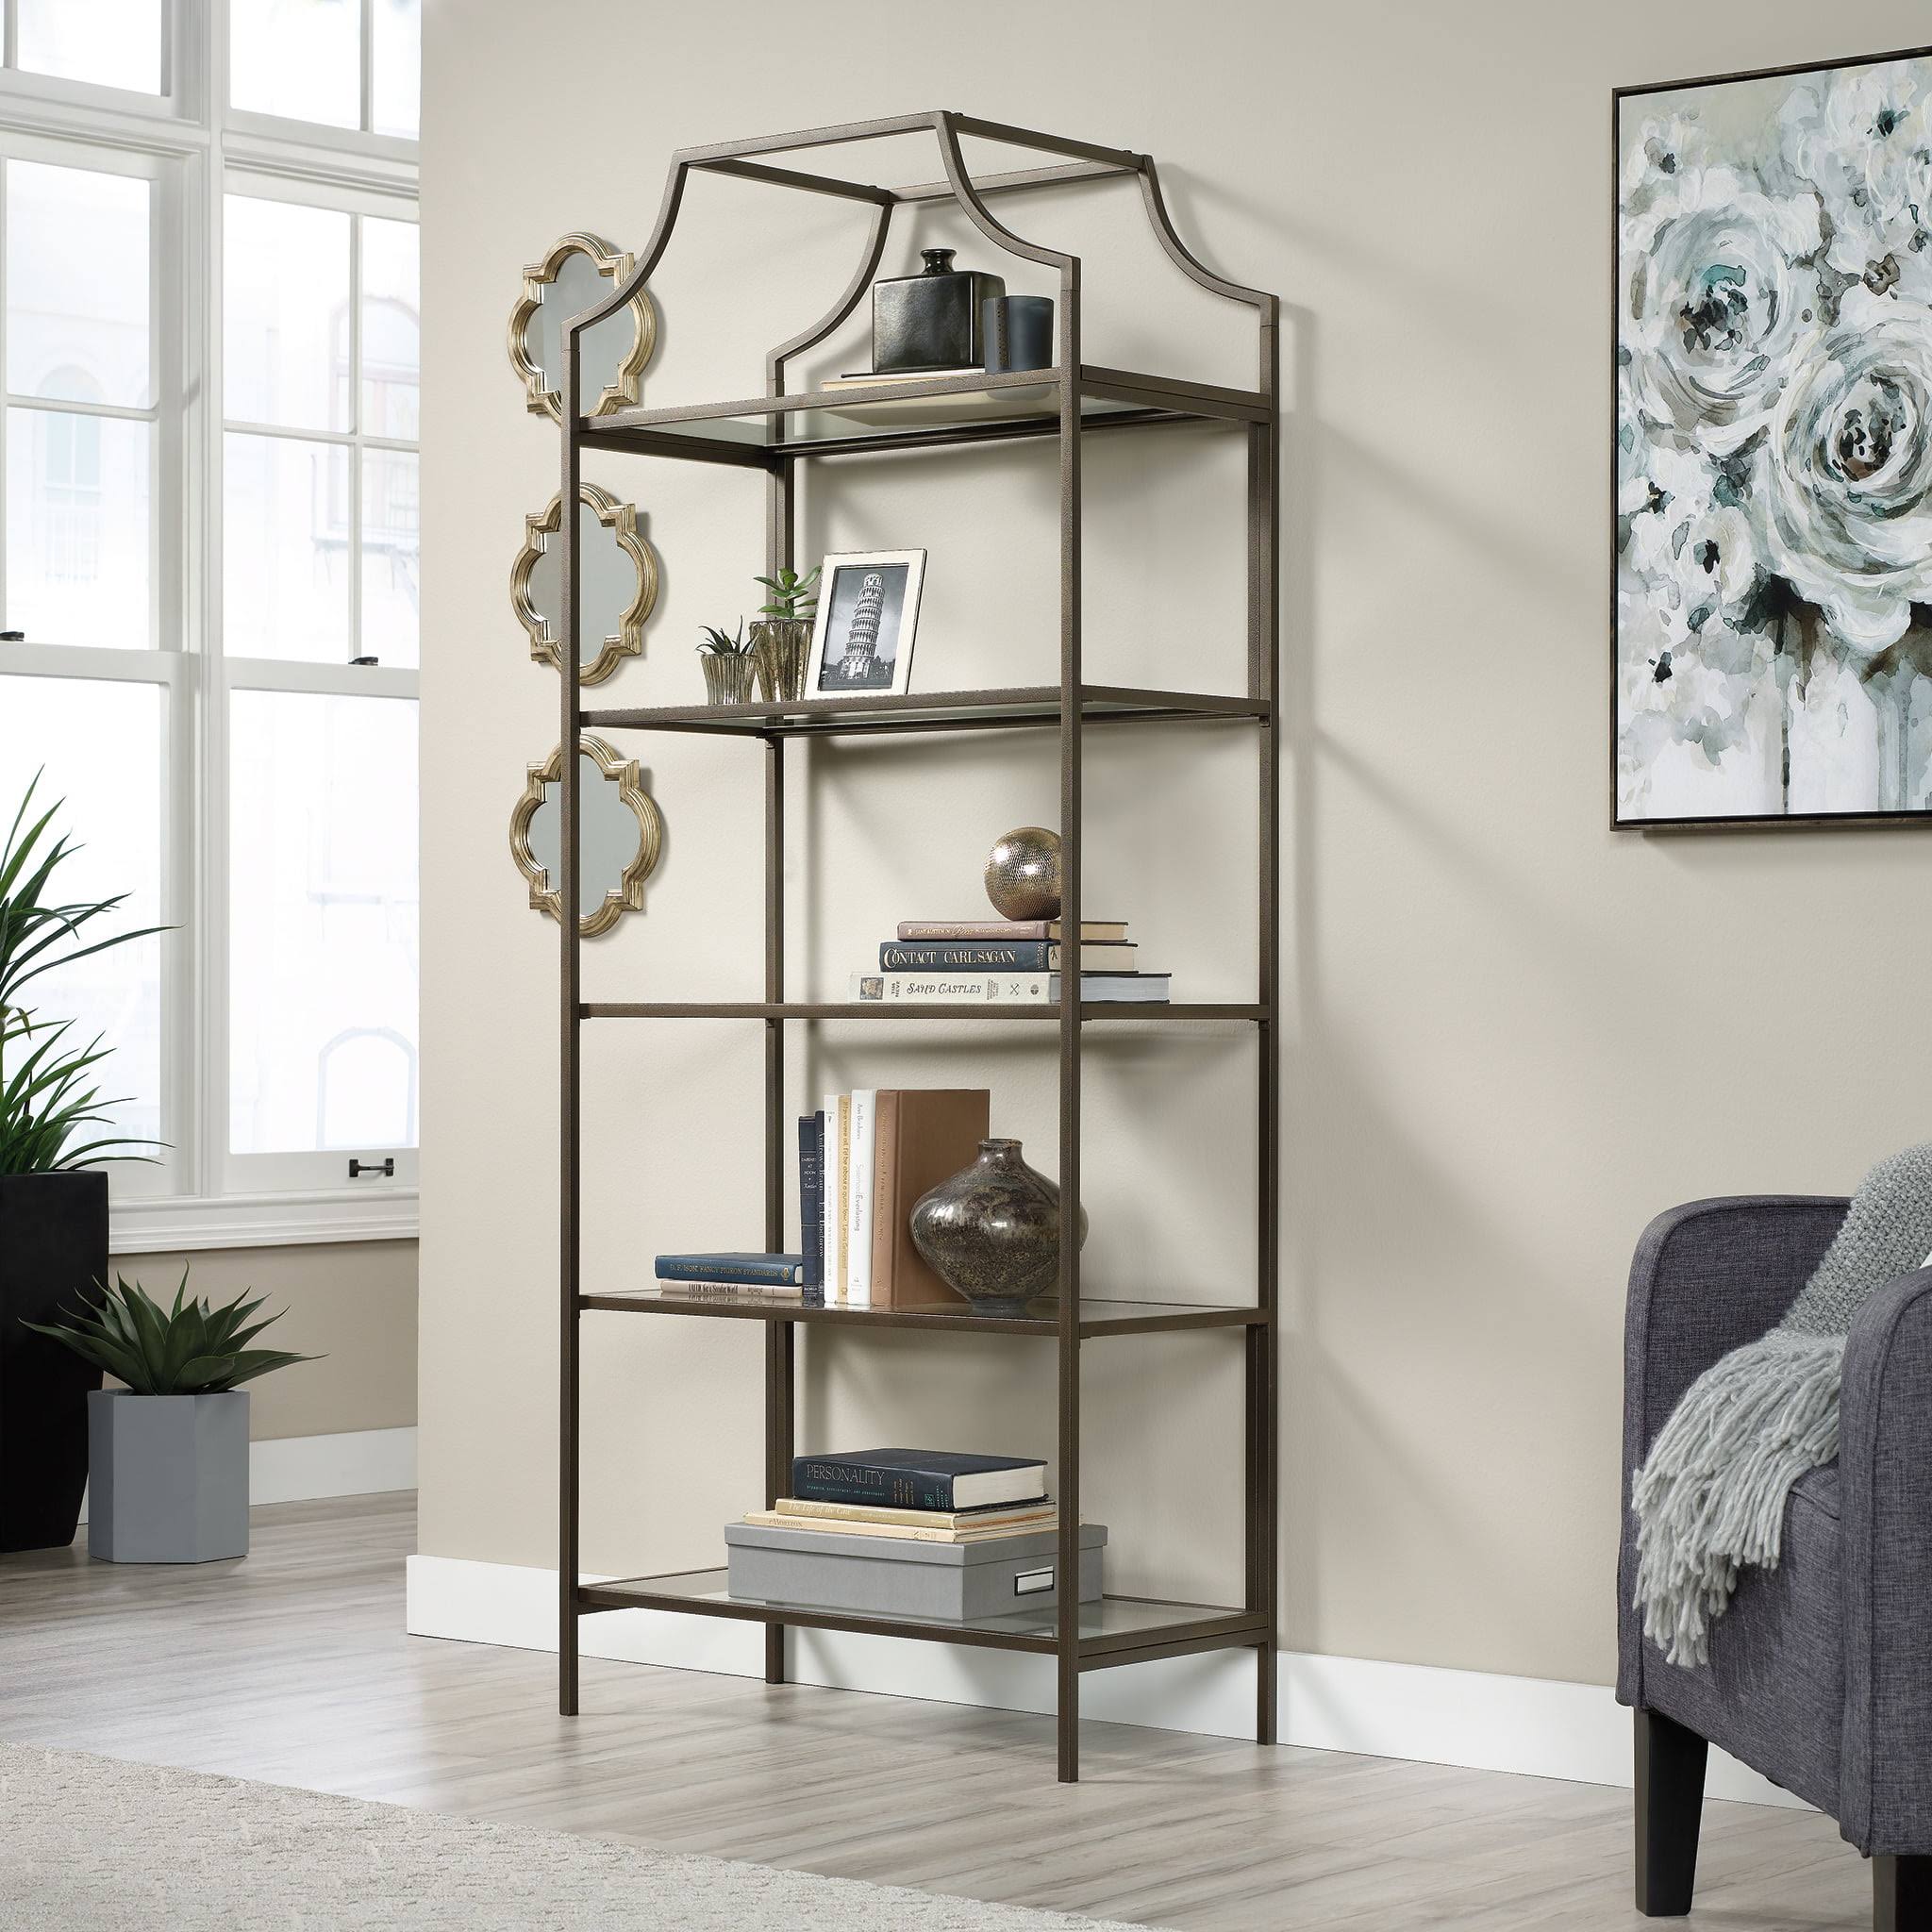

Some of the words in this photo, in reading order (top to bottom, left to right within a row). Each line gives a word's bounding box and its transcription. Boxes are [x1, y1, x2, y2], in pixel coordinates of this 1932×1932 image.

[884, 948, 937, 969] CONTACT
[944, 950, 976, 963] CARL
[978, 950, 1016, 963] SAGAN
[907, 983, 936, 994] SAND
[939, 983, 982, 994] CASTLES
[854, 1194, 864, 1232] Everlasting
[807, 1464, 885, 1486] PERSONALITY
